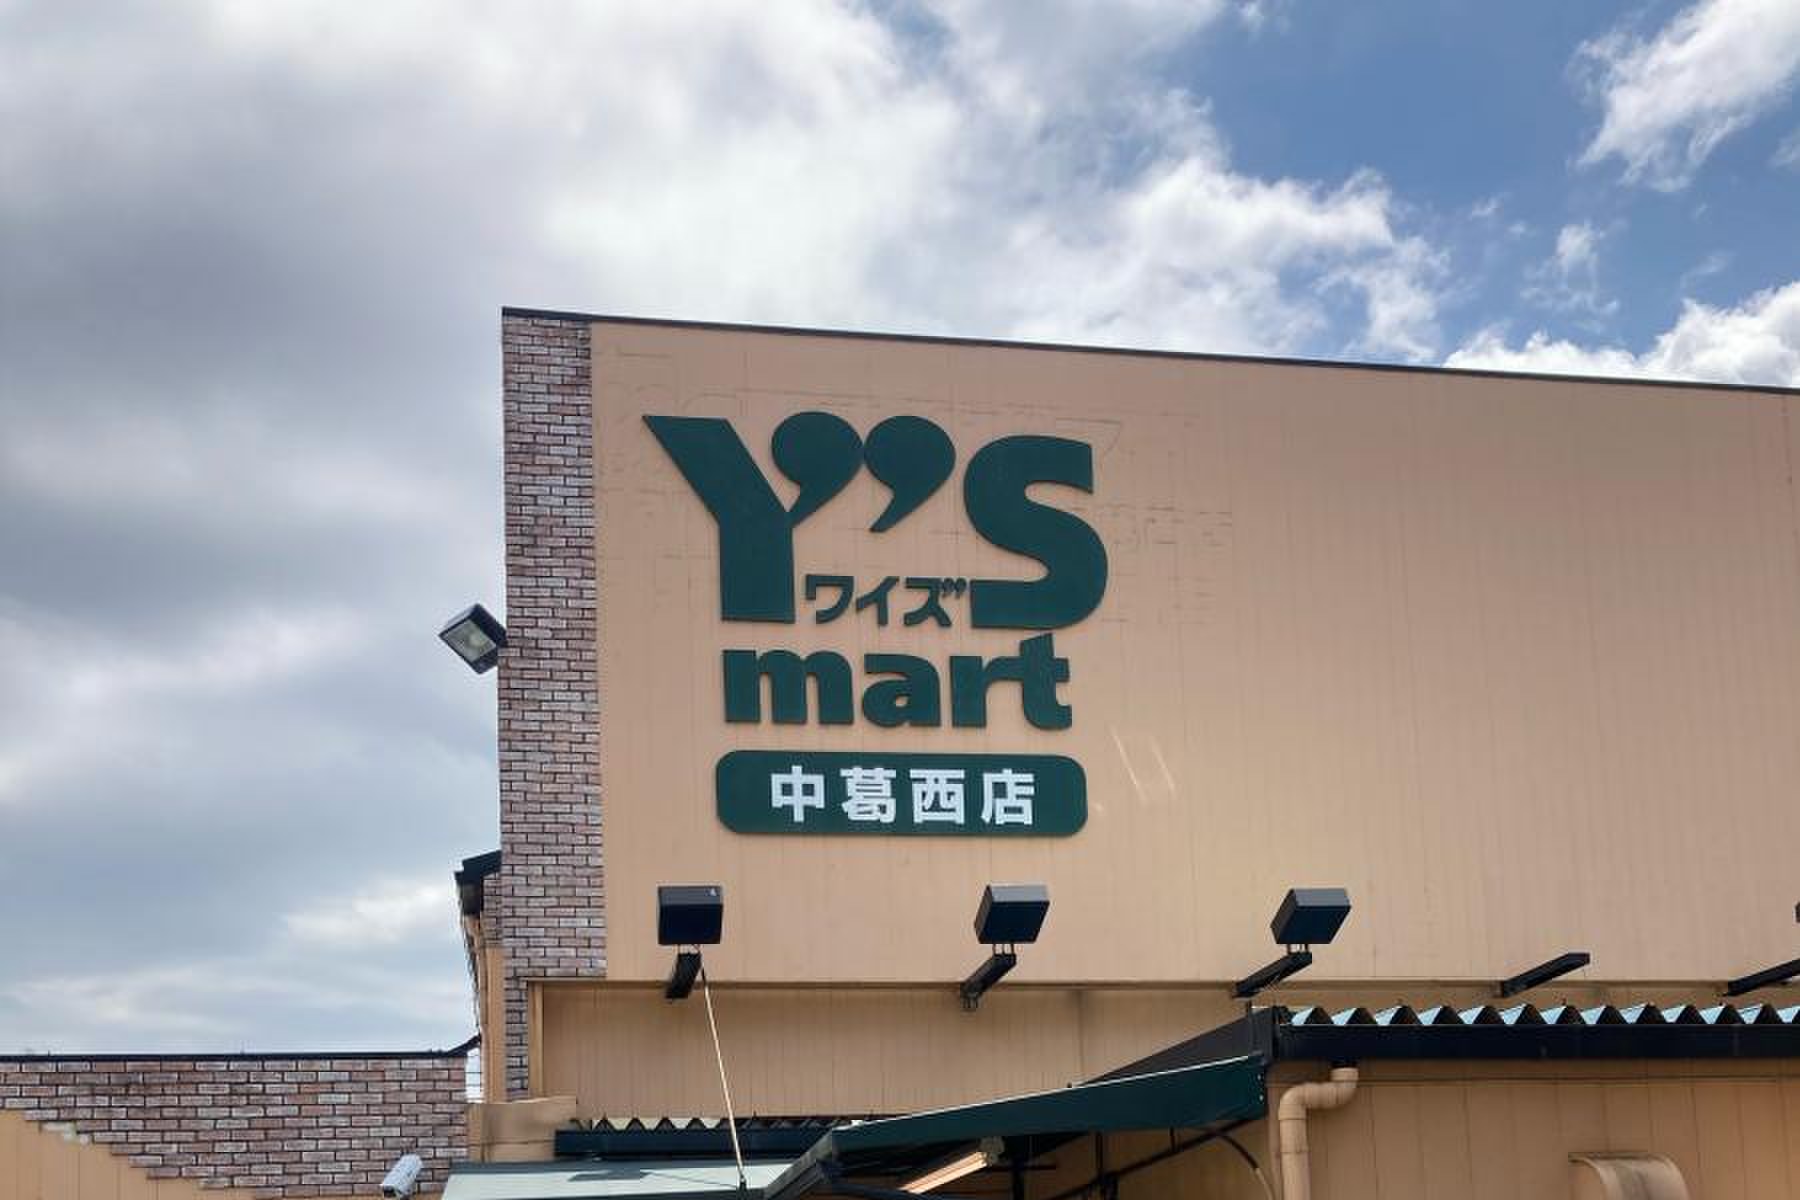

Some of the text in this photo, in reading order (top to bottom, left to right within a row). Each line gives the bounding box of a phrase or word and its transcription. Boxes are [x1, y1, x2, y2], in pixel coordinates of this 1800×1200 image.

[805, 574, 967, 627] ワイズ
[722, 632, 1073, 731] mart
[770, 765, 1037, 825] 中葛西店
